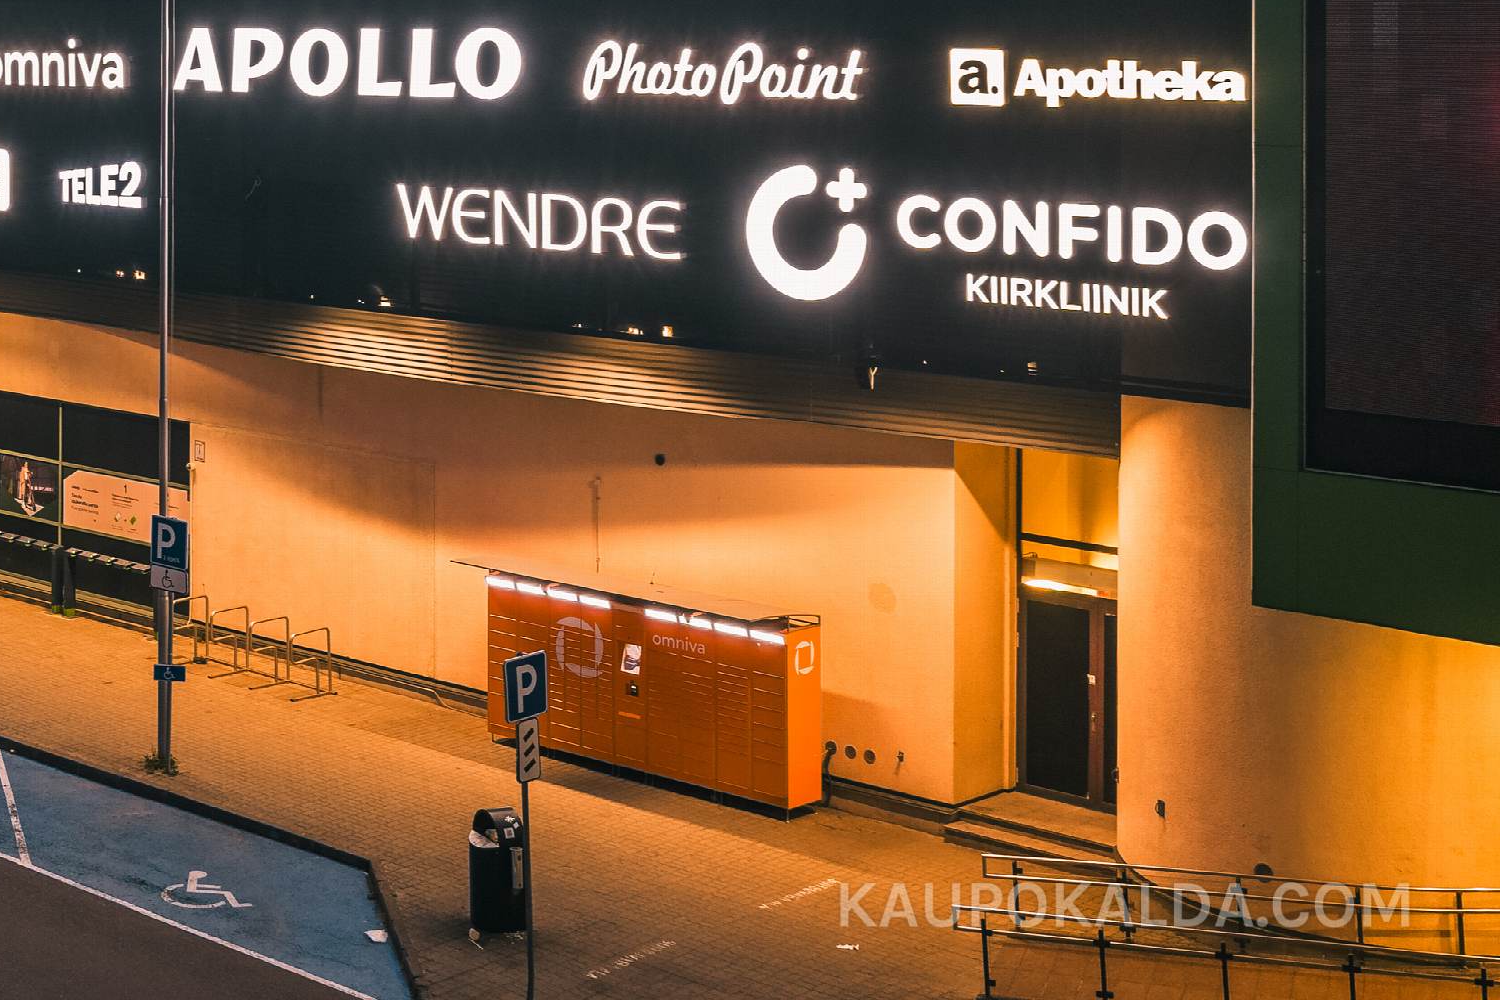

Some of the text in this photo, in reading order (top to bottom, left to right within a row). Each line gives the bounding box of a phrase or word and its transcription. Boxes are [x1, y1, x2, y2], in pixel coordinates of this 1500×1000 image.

[172, 27, 524, 101] APOLLO
[1013, 58, 1247, 108] Apotheka
[58, 160, 143, 209] TELE2
[396, 182, 684, 260] WENDRE
[896, 193, 1248, 271] CONFIDO
[965, 272, 1169, 320] KIIRKLIINIK
[156, 522, 176, 559] P
[652, 634, 706, 655] omniva
[516, 664, 538, 714] P
